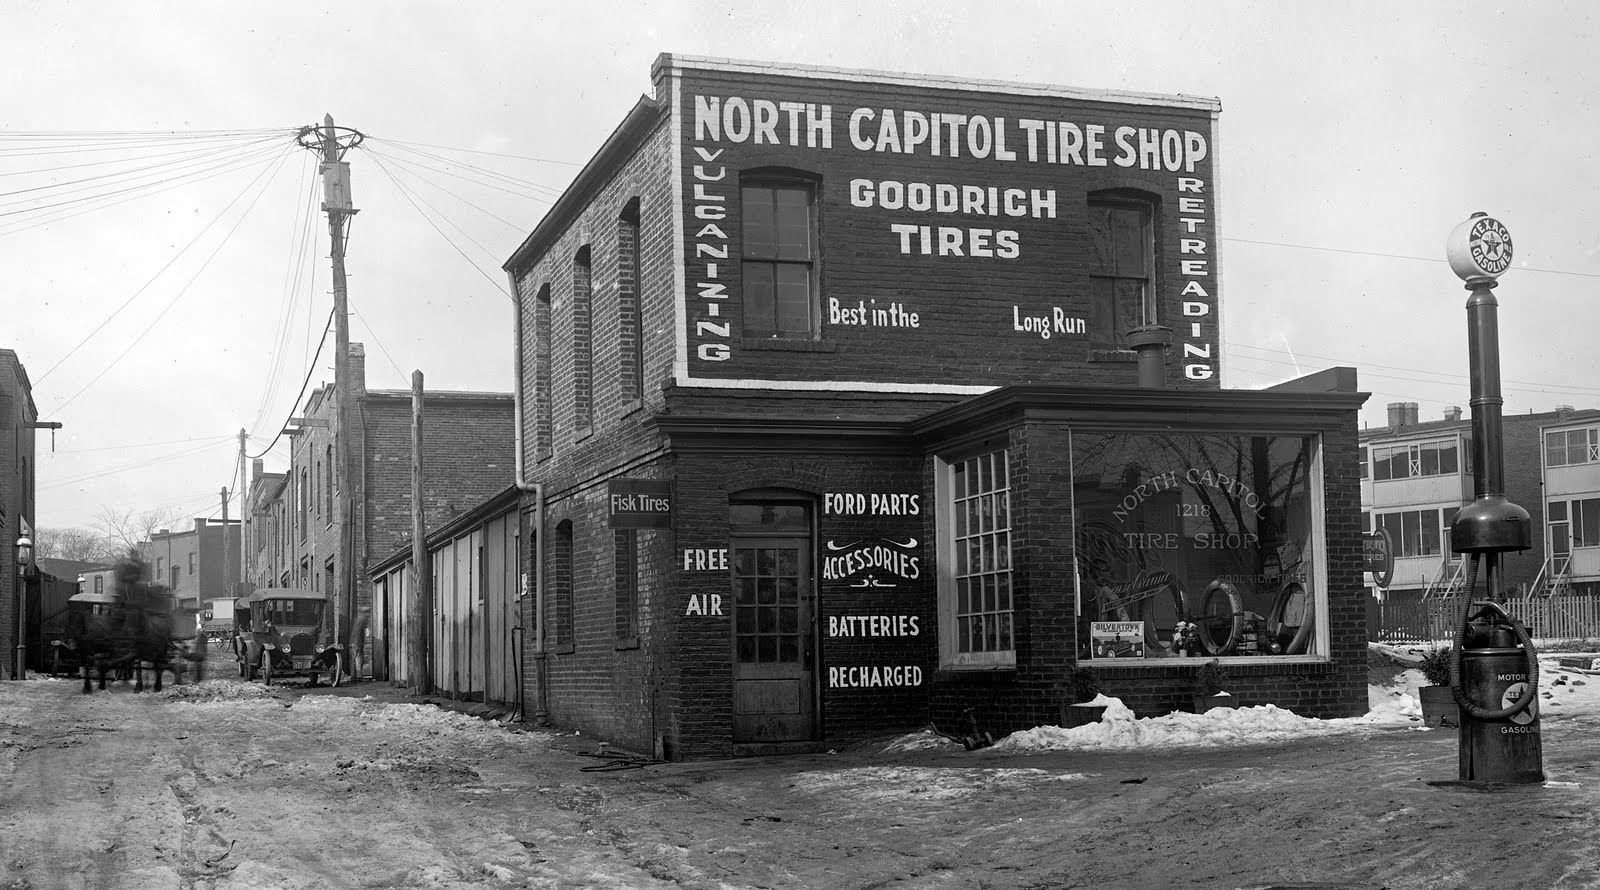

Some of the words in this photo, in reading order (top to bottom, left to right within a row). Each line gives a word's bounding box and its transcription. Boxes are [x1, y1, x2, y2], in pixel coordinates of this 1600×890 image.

[695, 95, 832, 149] NORTH
[849, 107, 1016, 161] CAPITOL
[1018, 118, 1107, 167] TIRE
[1113, 125, 1208, 173] SHOP
[849, 178, 1057, 219] GOODRICH
[890, 223, 1020, 259] TIRES
[1472, 219, 1509, 242] TEXACO
[693, 146, 731, 362] VULCANIZING
[1473, 247, 1510, 272] GASOLINE
[1177, 176, 1214, 381] RETREADING
[828, 297, 866, 326] Best
[871, 299, 889, 327] in
[889, 301, 920, 328] the
[1013, 305, 1051, 340] Long
[1053, 306, 1086, 335] Run
[611, 494, 636, 515] Fisk
[638, 494, 669, 512] Tires
[824, 493, 866, 515] FORD
[871, 494, 919, 515] PARTS
[1112, 470, 1178, 524] NORTH
[1186, 468, 1268, 521] CAPITOL
[1176, 504, 1211, 518] 1218
[1123, 533, 1179, 550] TIRE
[684, 549, 729, 570] FREE
[823, 546, 919, 580] ACCESSORIES
[1218, 574, 1271, 584] GOODRICH
[686, 594, 722, 615] AIR
[829, 615, 919, 637] BATTERIES
[1095, 623, 1139, 631] SILVERTOWN
[829, 666, 922, 687] RECHARGED
